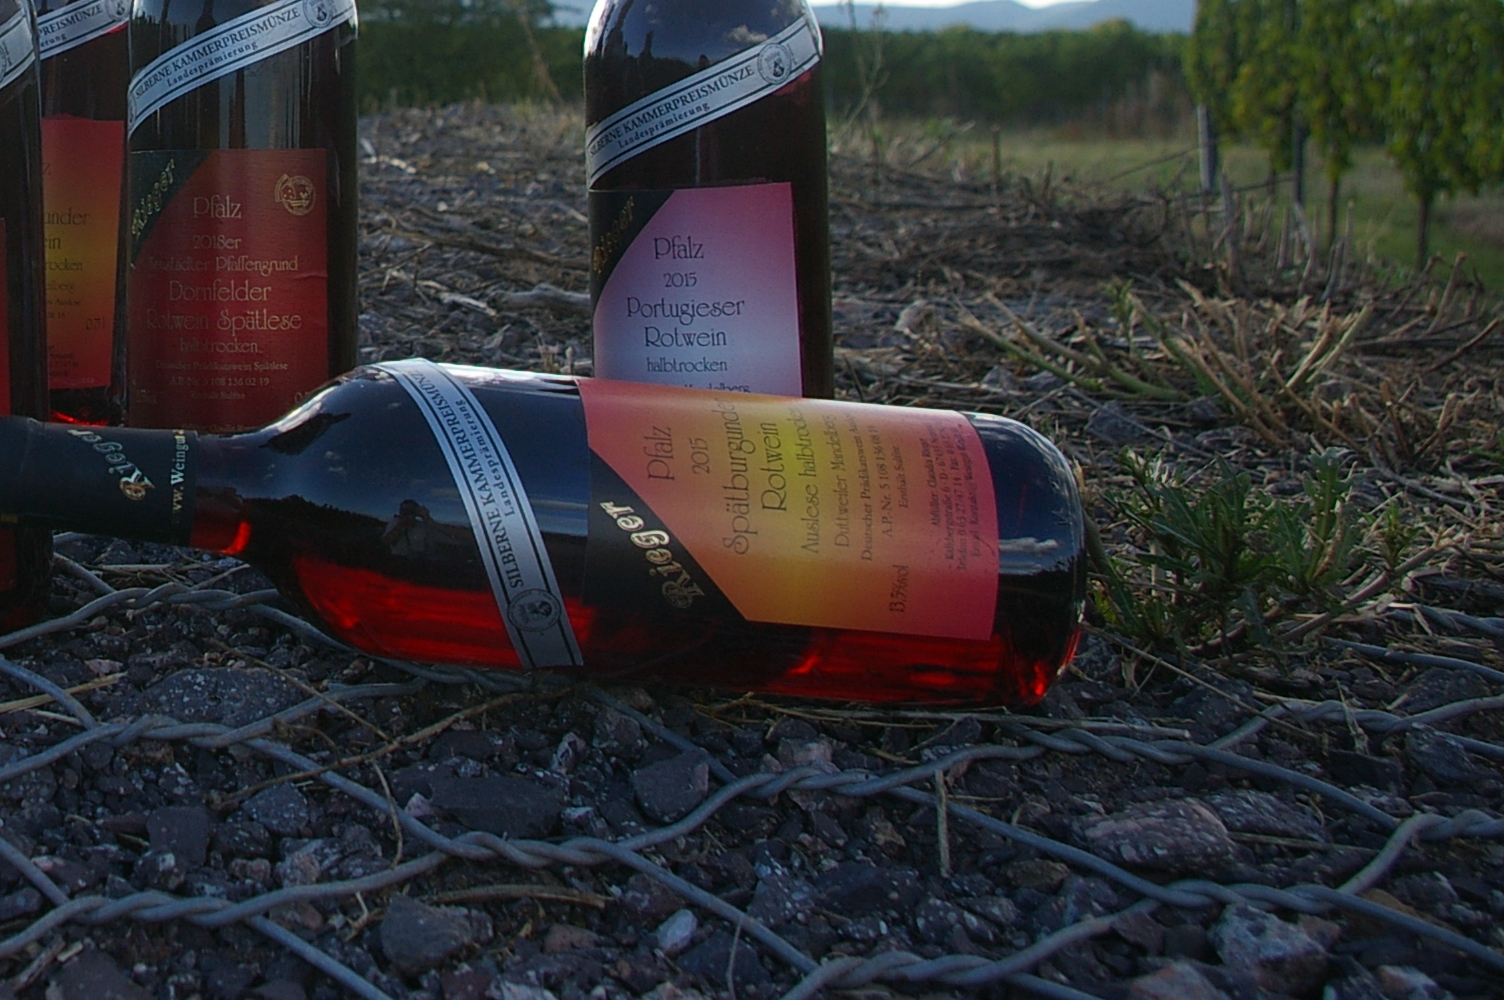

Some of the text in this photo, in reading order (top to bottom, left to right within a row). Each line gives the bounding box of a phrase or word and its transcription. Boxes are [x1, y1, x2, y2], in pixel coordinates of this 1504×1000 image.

[172, 6, 301, 72] KAMMERPREISMÜNZE
[166, 41, 258, 87] Landesprämierung
[622, 64, 755, 133] KAMMERPREISMÜNZE
[617, 102, 710, 149] Landesprämierung
[132, 158, 175, 239] Rieger
[193, 194, 242, 219] Pfalz
[192, 235, 242, 249] 2018er
[654, 235, 704, 260] Pfalz
[216, 255, 299, 277] Pfaffengrund
[663, 272, 697, 288] 2015
[169, 279, 272, 301] Dornfelder
[627, 296, 745, 326] Portugieser
[147, 308, 302, 337] Rotwein Spätlese
[644, 326, 727, 347] Rotwein
[180, 337, 258, 354] halbtrocken
[647, 357, 728, 372] halbtrocken
[67, 430, 155, 501] Rieger
[455, 398, 515, 517] Landesprämierung
[642, 426, 675, 481] Pfalz
[688, 437, 710, 475] 2015
[757, 422, 787, 511] Rotwein
[877, 463, 889, 480] 108
[822, 413, 849, 547] Duttweiler Mandelberg
[879, 482, 890, 490] 5
[800, 483, 819, 554] Auslese
[861, 502, 872, 561] Deutscher
[485, 508, 524, 588] SILBERNE
[600, 501, 704, 609] Rieger
